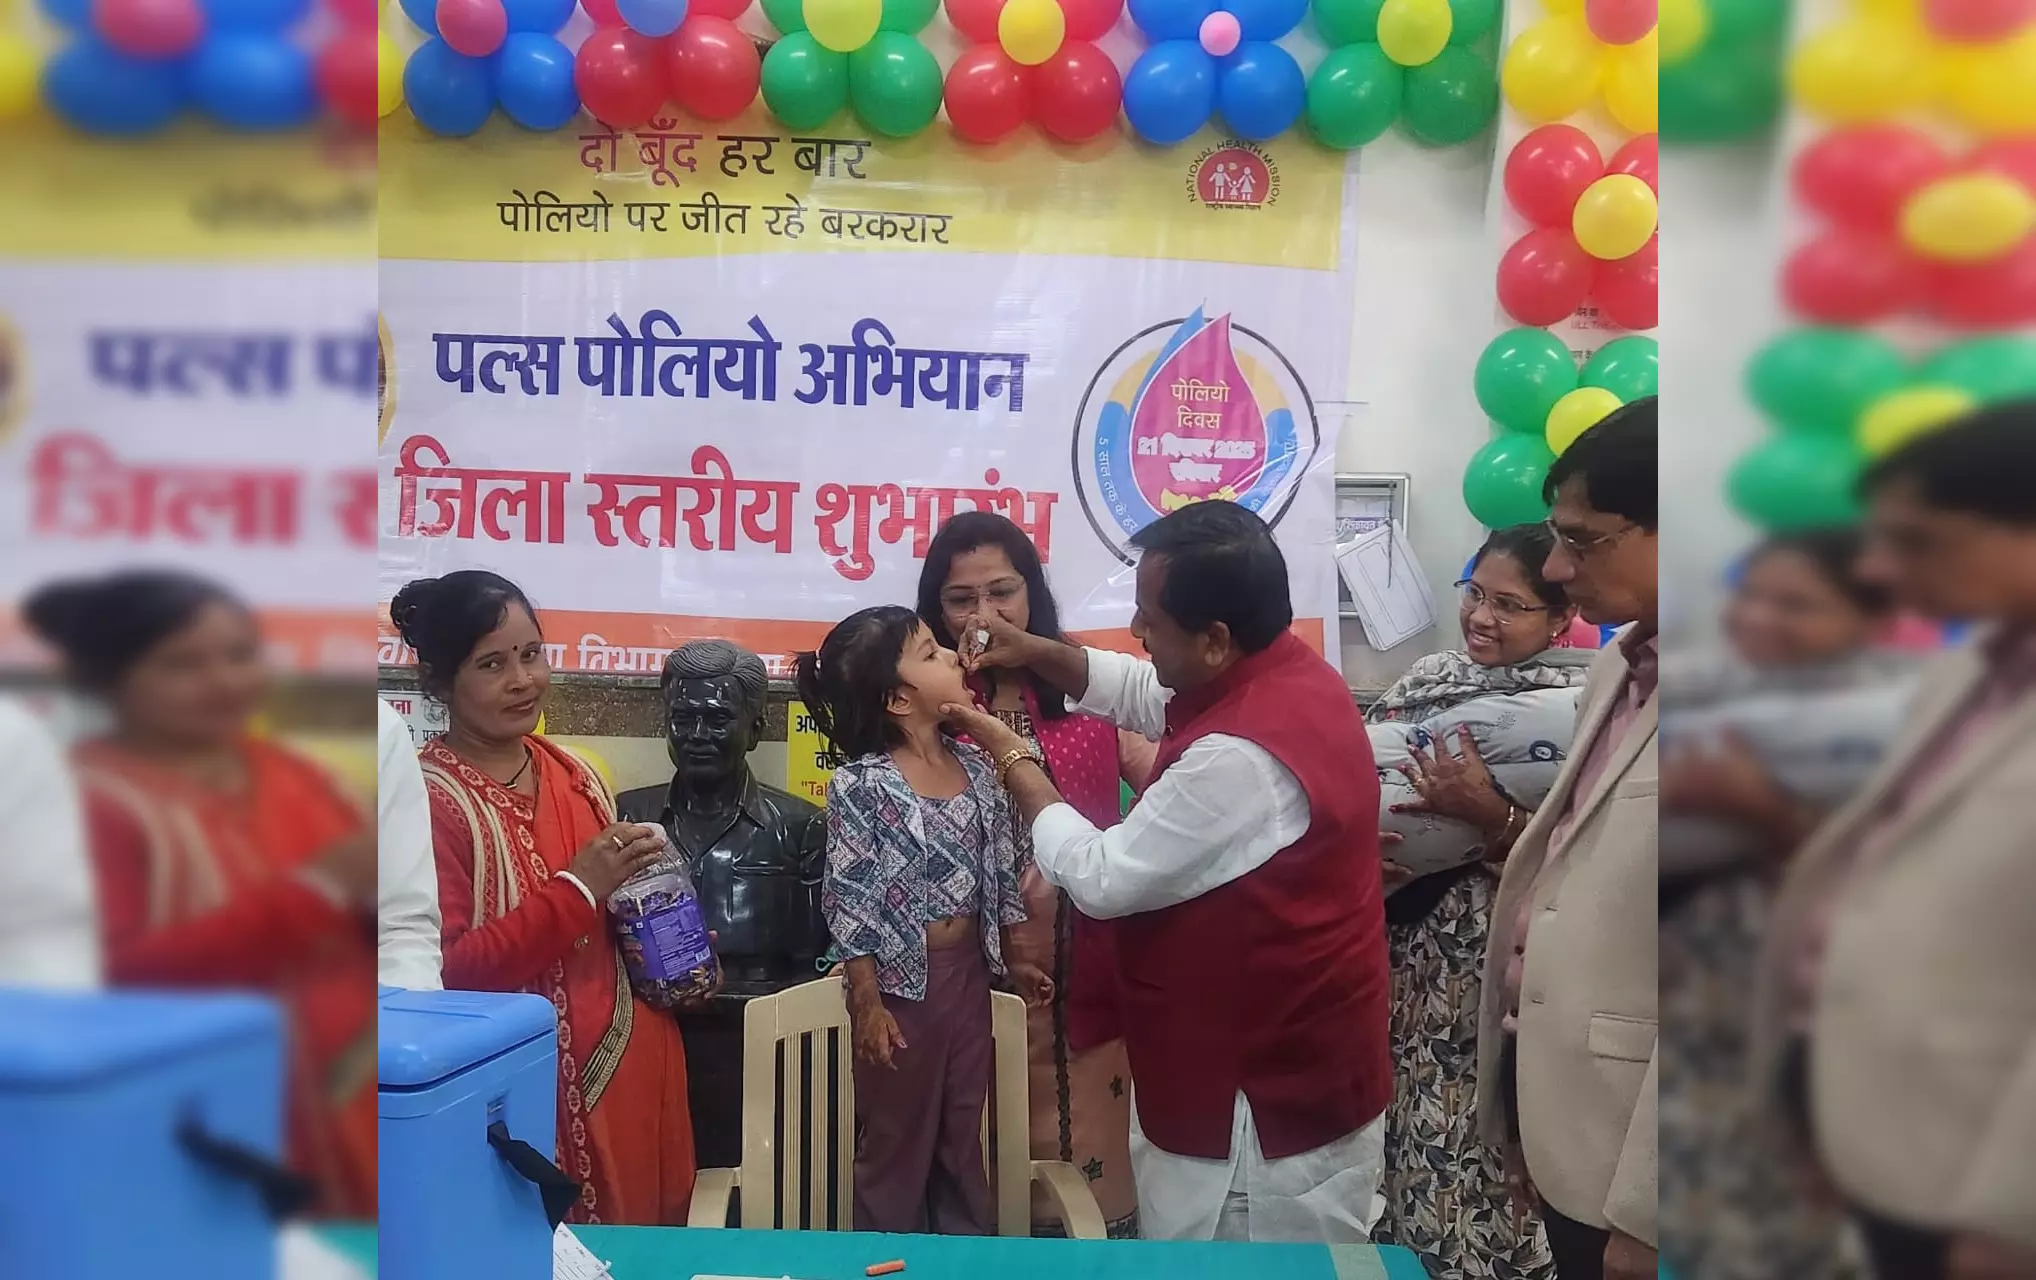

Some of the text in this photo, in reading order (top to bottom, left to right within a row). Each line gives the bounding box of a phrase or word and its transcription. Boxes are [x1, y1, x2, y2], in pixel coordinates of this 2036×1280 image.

[579, 117, 871, 188] दो बूँद हर बार
[1186, 140, 1281, 207] NATIONAL HEALTH MISSION
[497, 189, 953, 245] पोलियो पर जीत रहे बरकरार
[433, 332, 565, 396] पल्स
[574, 308, 782, 402] पोलियो
[794, 317, 1030, 412] अभियान
[1170, 378, 1231, 403] पोलियो
[1177, 405, 1223, 429] दिवस
[395, 434, 571, 544] जिला
[584, 444, 800, 554] स्तरीय
[814, 467, 1058, 582] शुभांभ
[1098, 436, 1140, 533] 5 साल तक के हर
